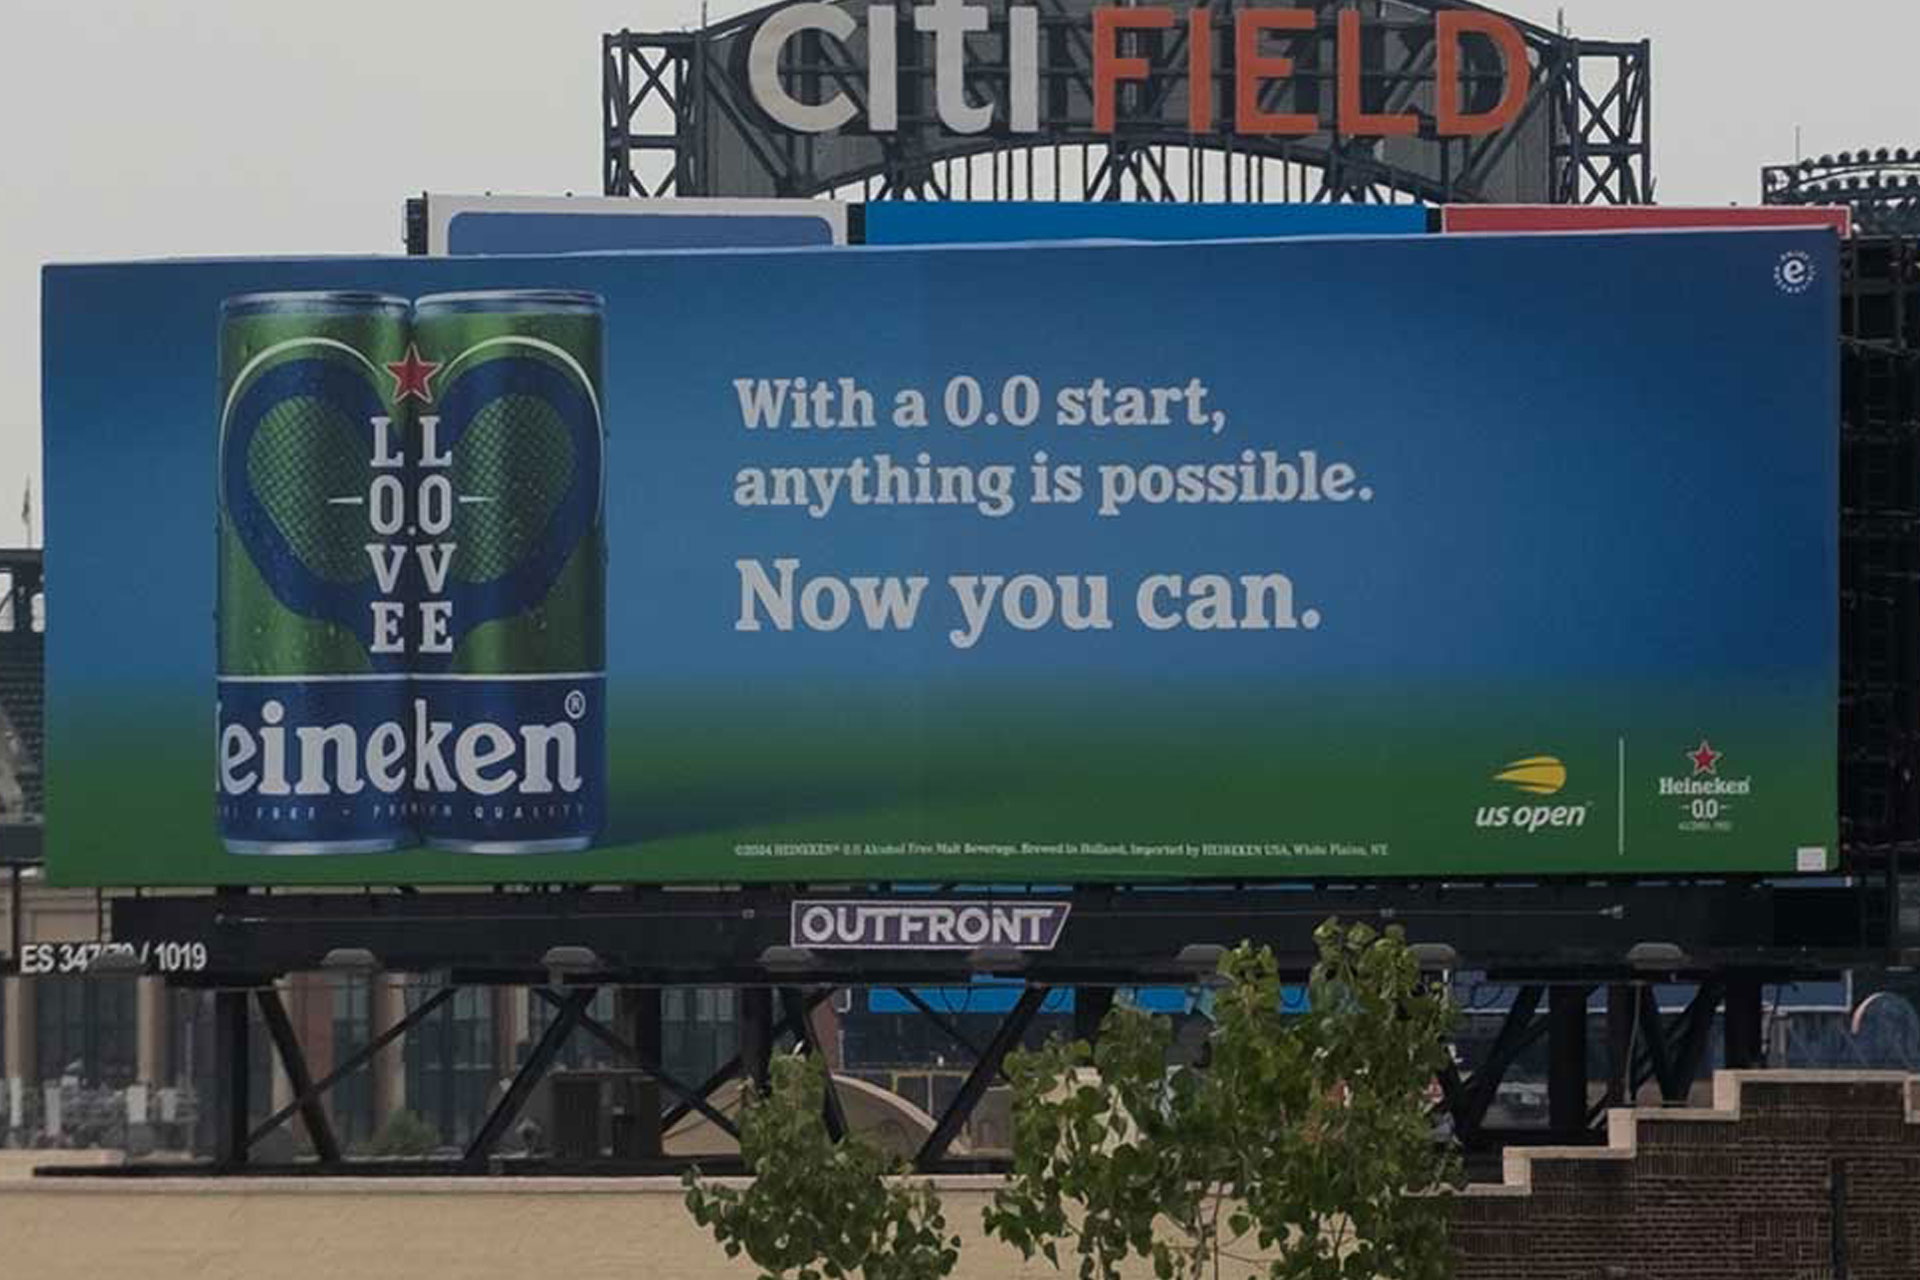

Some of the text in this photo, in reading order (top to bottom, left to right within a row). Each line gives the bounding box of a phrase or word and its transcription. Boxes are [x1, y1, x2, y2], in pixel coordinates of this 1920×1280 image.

[1092, 6, 1532, 136] FIELD
[733, 374, 1227, 434] With a 0.0 start,
[733, 448, 1375, 518] anything is possible.
[733, 558, 1322, 648] Now you can.
[1475, 802, 1585, 833] us open
[801, 905, 1055, 942] OUTFRONT
[20, 944, 55, 974] ES
[154, 942, 208, 972] 1019
